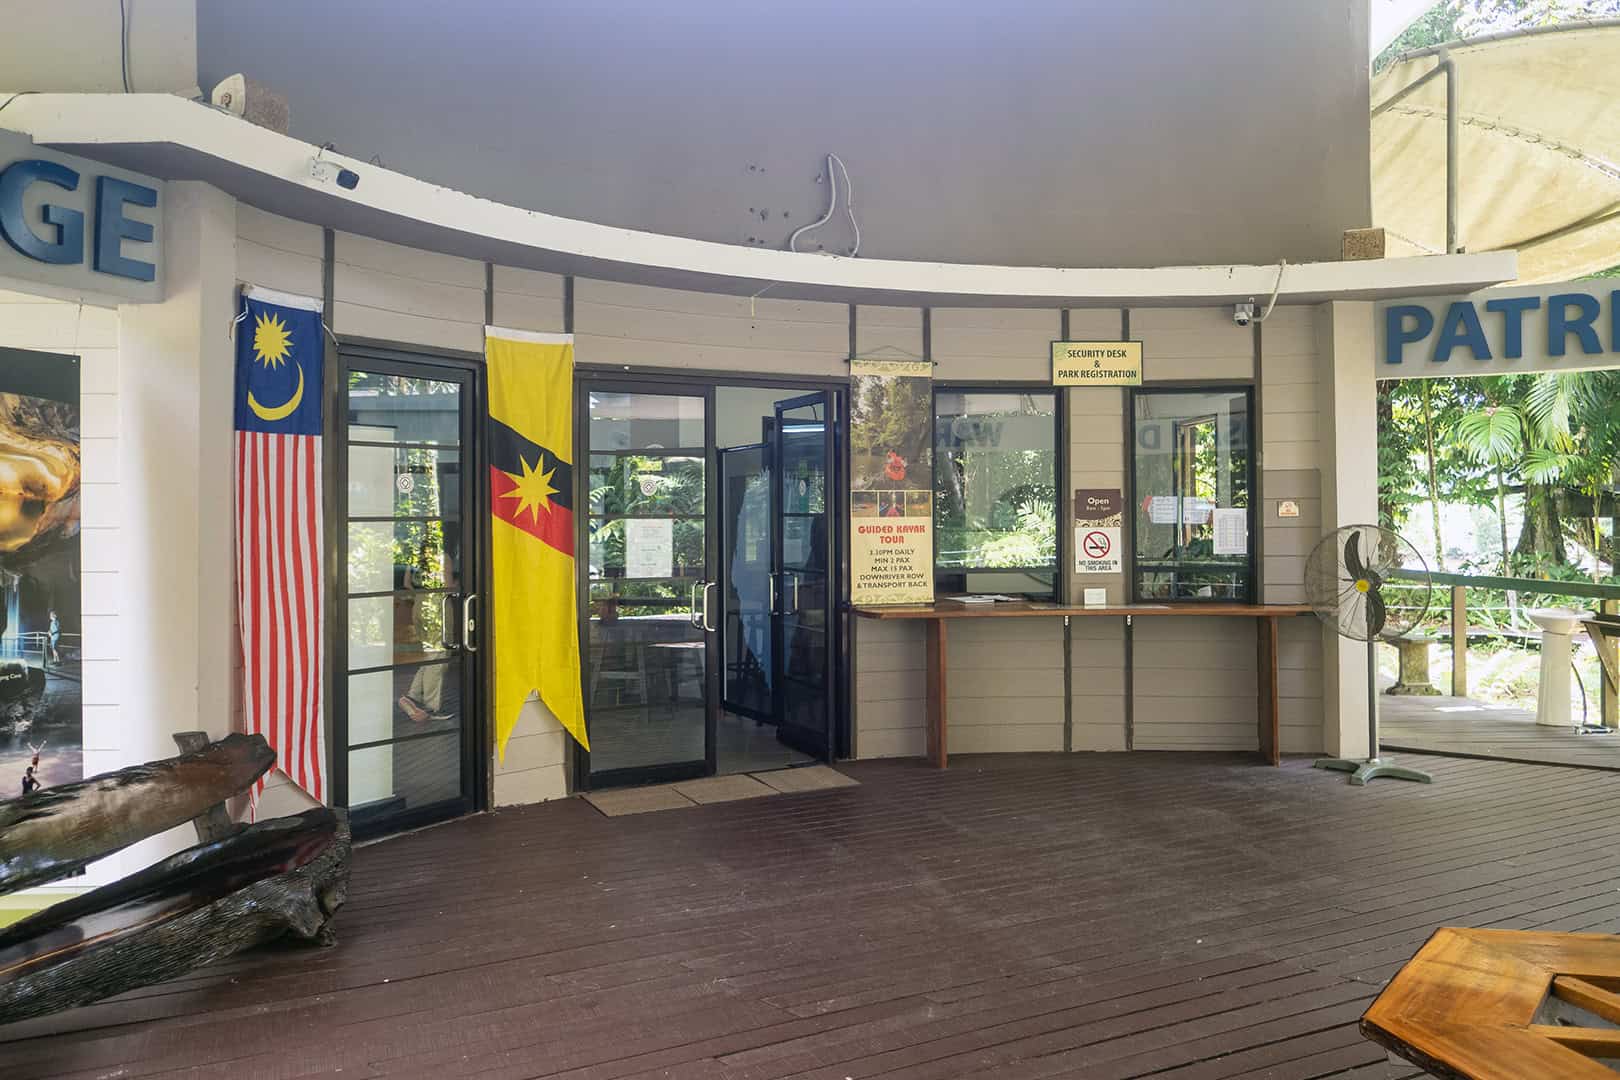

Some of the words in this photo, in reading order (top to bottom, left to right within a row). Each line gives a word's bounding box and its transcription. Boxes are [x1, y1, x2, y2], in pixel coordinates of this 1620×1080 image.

[1067, 350, 1105, 358] SECURITY
[1106, 350, 1127, 358] DESK
[1094, 359, 1100, 368] &
[1058, 370, 1079, 378] PARK
[1080, 370, 1137, 378] REGISTRATION
[1088, 497, 1109, 505] Open
[858, 526, 893, 534] GUIDED
[896, 525, 926, 533] KAYAK
[880, 536, 904, 544] TOUR
[862, 581, 907, 589] TRANSPORT
